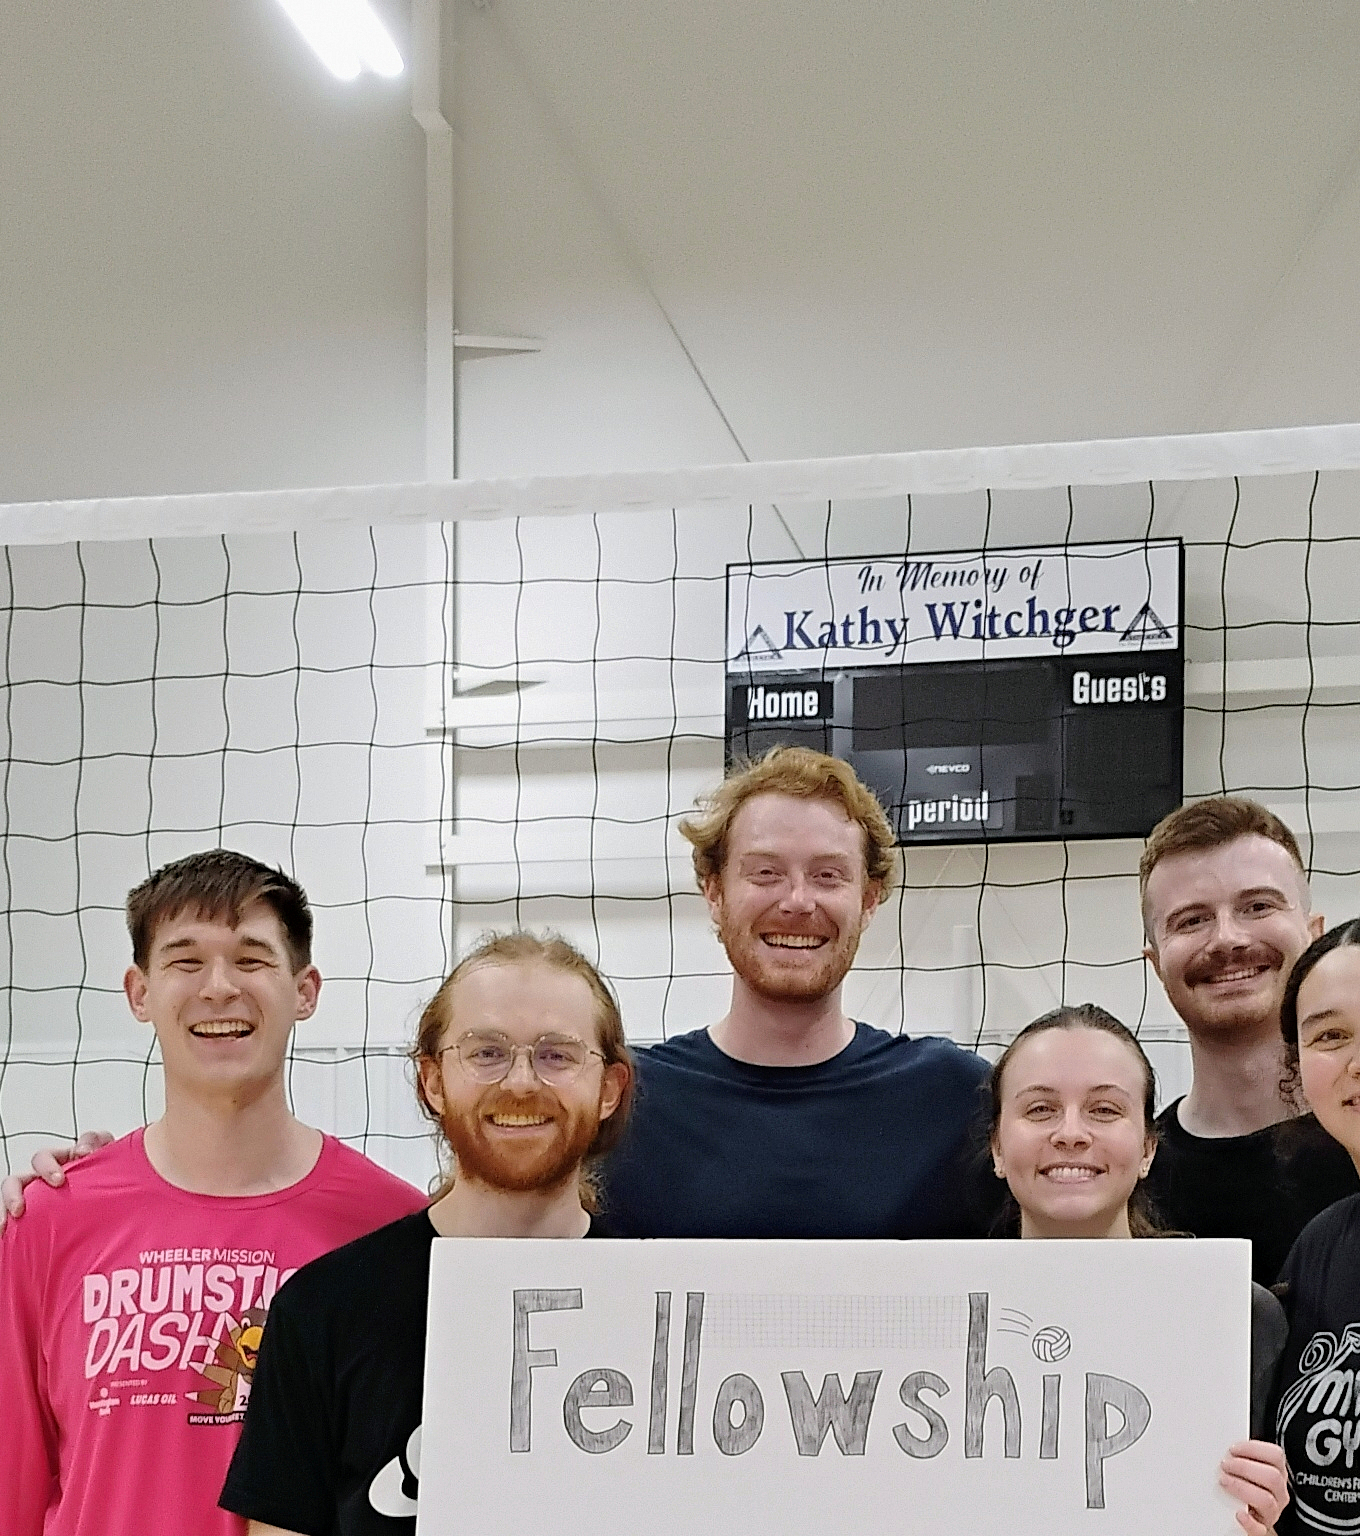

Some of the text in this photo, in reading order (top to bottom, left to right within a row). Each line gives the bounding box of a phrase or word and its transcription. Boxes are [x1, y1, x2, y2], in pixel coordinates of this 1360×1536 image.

[858, 559, 1044, 594] In Memory of
[784, 596, 1123, 656] Kathy Witchger
[747, 687, 818, 720] Home
[1073, 671, 1167, 704] Guests
[908, 790, 989, 829] period
[139, 1247, 275, 1265] WHEELER MISSION
[85, 1311, 225, 1379] DASH
[130, 1393, 178, 1405] LUCAS OIL
[509, 1287, 1152, 1509] Fellowship
[189, 1415, 214, 1424] MOVE
[1296, 1471, 1352, 1490] CHILDREN'S
